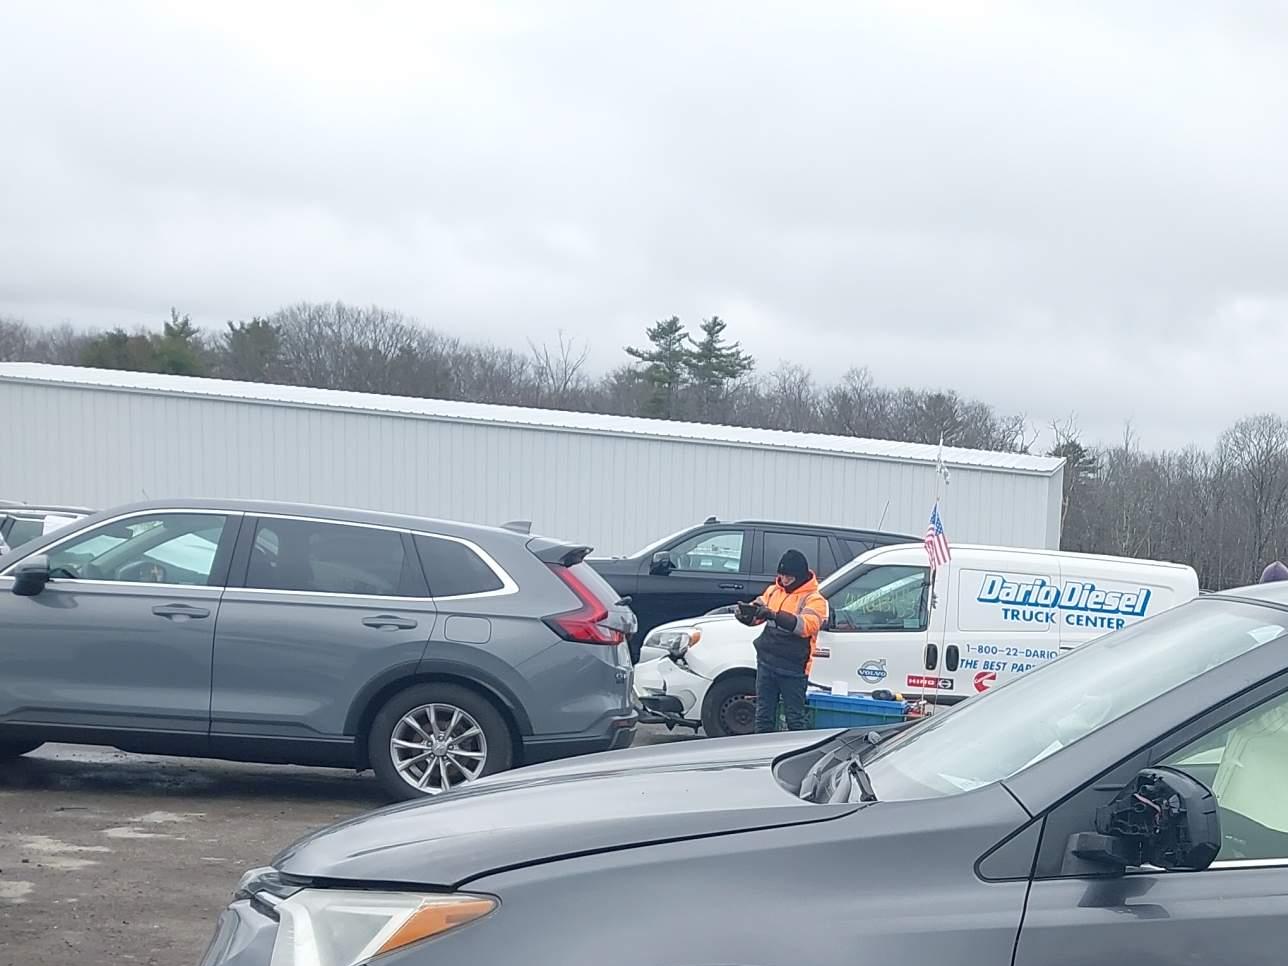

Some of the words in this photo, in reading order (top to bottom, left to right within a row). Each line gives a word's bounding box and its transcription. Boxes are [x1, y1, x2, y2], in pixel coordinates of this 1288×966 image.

[977, 574, 1060, 608] Dario
[1058, 580, 1151, 616] Diesel
[1002, 608, 1056, 624] TRUCK
[1066, 613, 1126, 630] CENTER
[966, 643, 1058, 660] 1-800-22-DARIO
[959, 658, 979, 670] THE
[983, 660, 1007, 672] BEST
[858, 669, 886, 677] VOLVO
[908, 677, 936, 686] HINO
